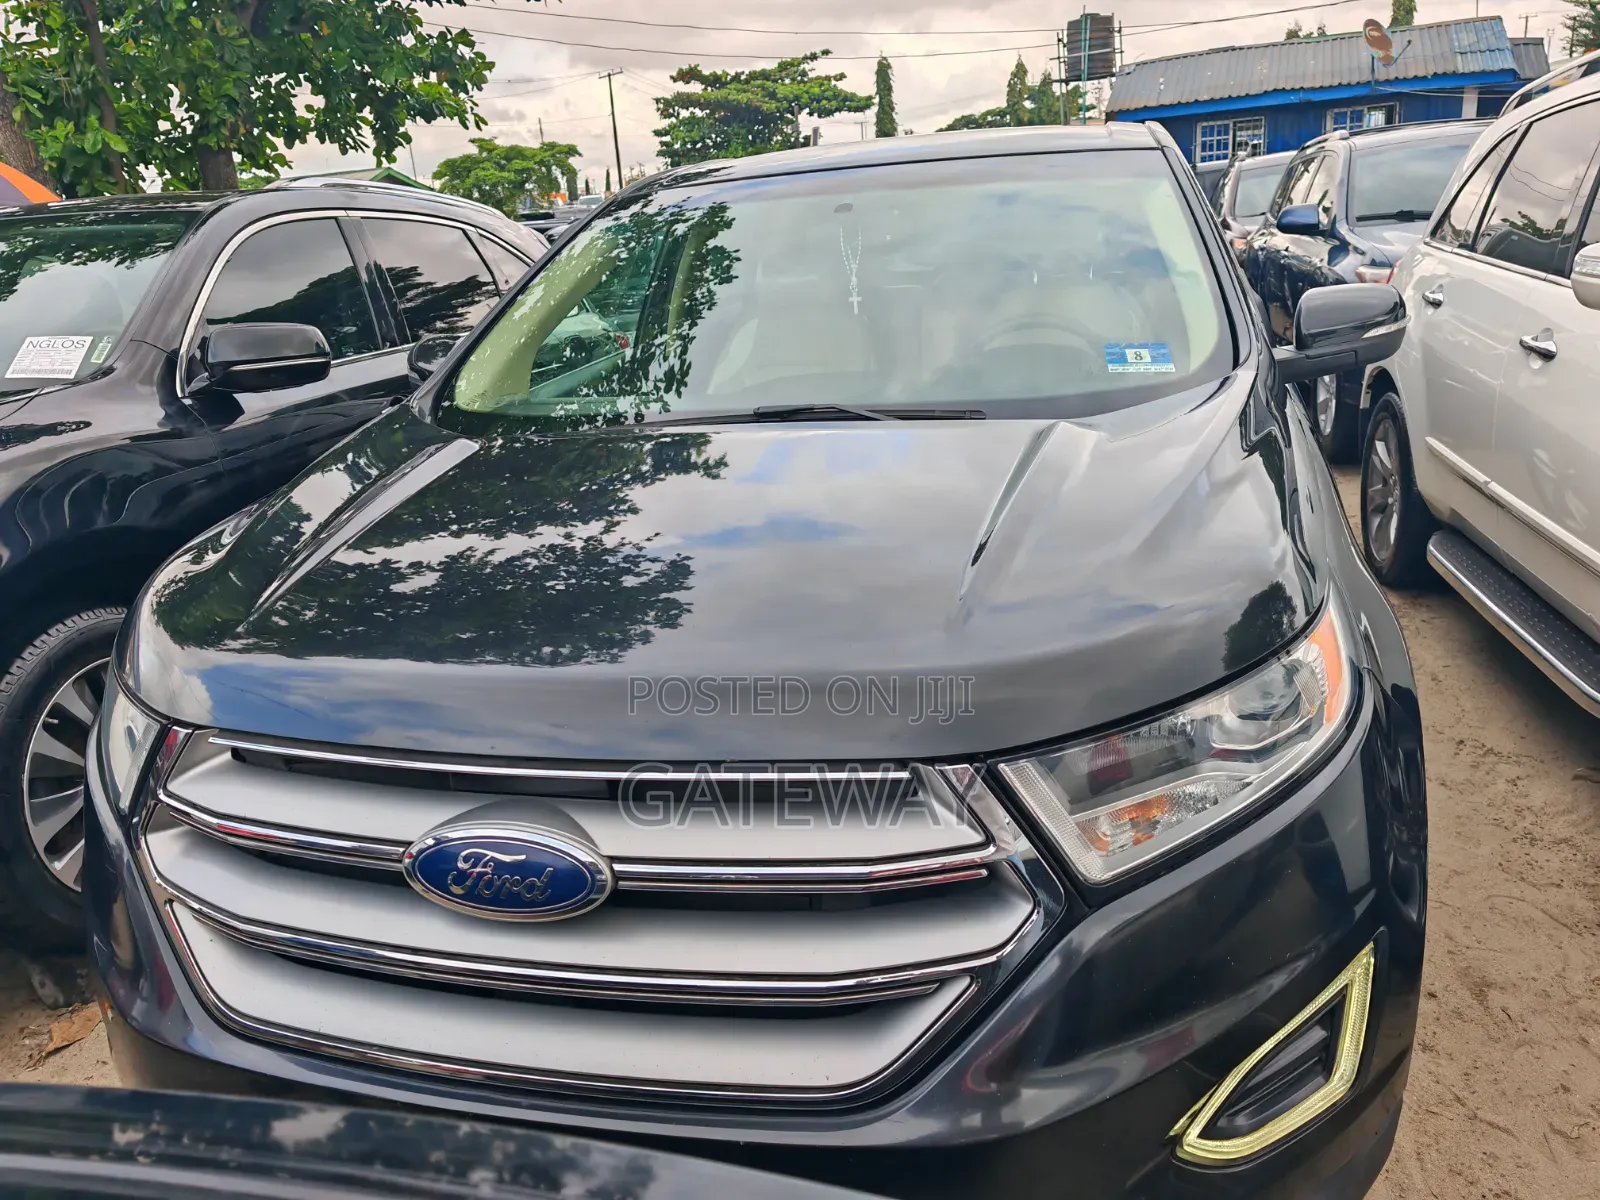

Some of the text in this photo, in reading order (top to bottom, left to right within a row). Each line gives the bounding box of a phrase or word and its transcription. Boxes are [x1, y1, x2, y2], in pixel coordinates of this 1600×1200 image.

[26, 339, 87, 349] NGLOS
[1133, 351, 1144, 361] 8
[446, 848, 554, 902] Ford
